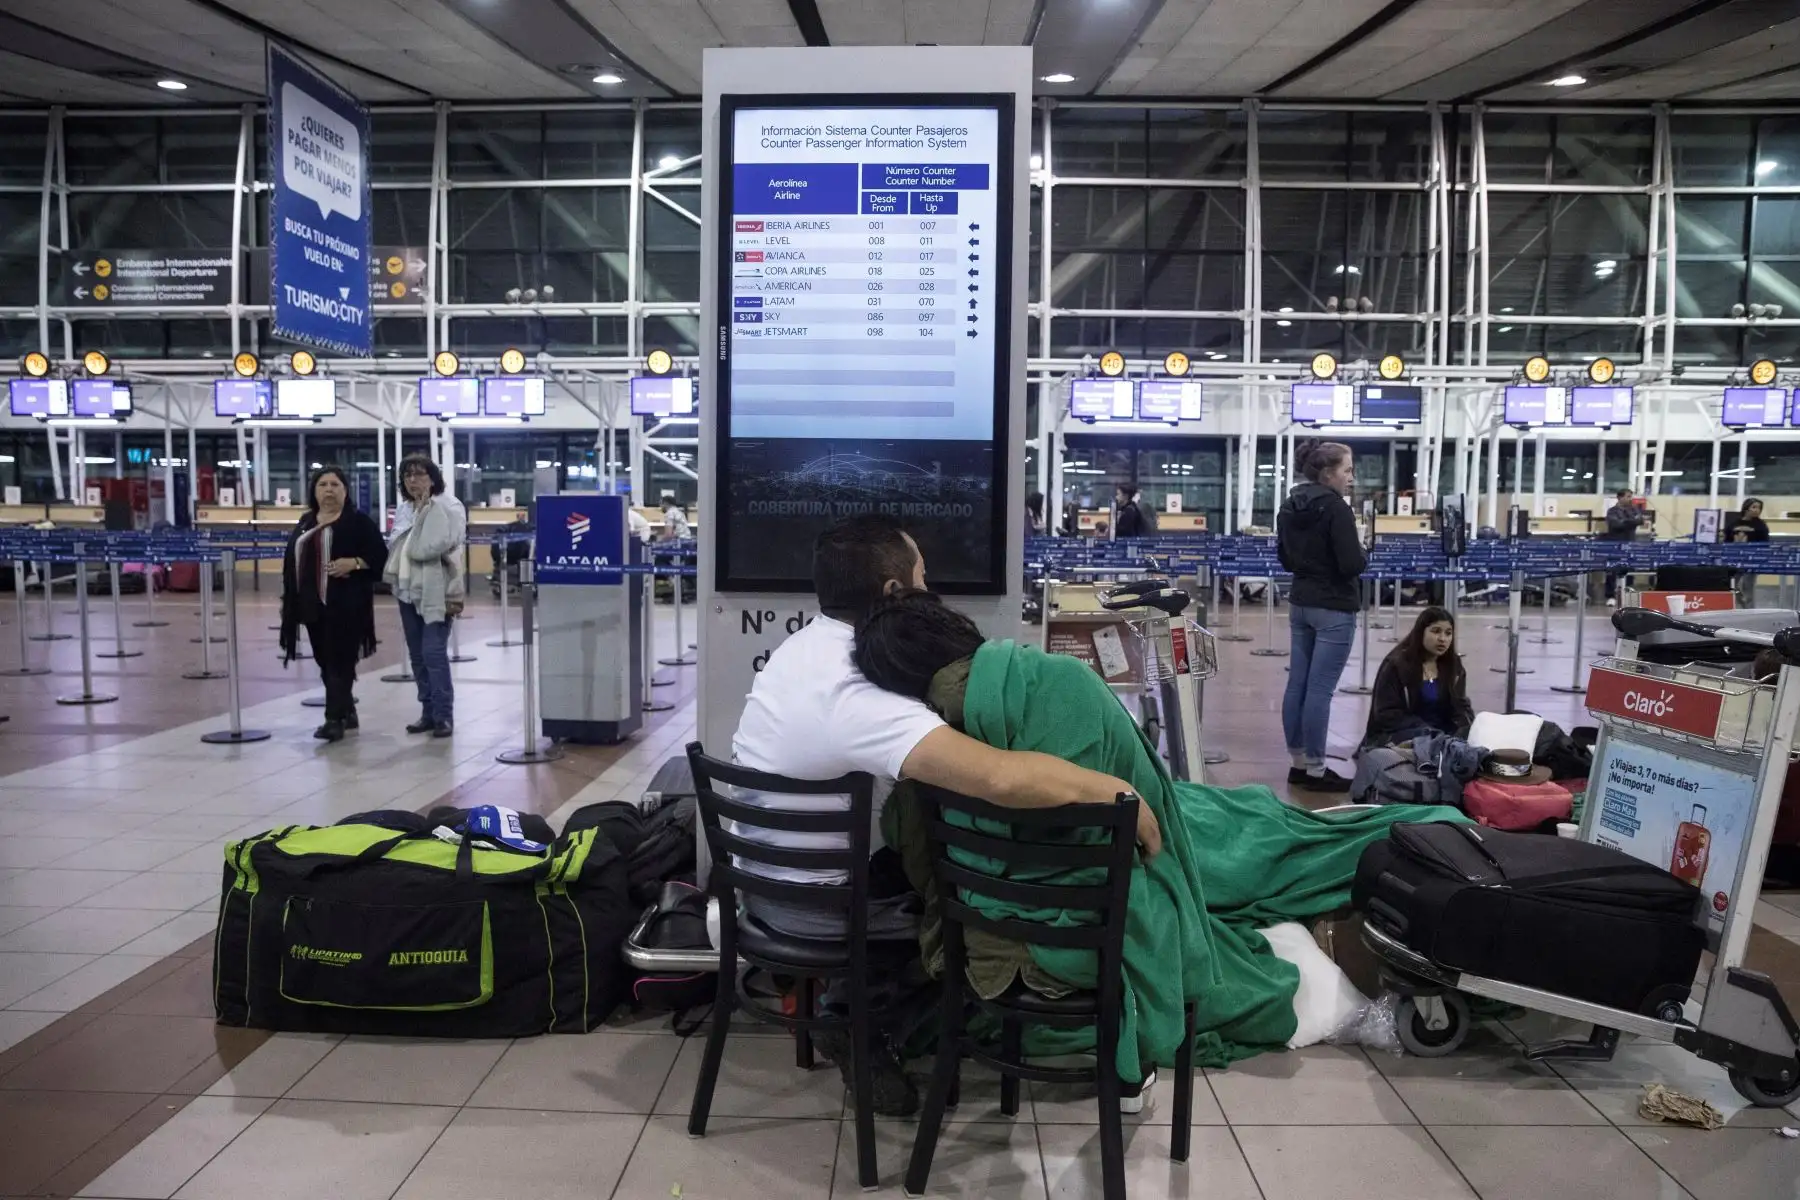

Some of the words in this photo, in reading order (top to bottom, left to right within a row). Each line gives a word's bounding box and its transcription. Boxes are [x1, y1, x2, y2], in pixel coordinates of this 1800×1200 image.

[301, 116, 344, 150] ¿QUIERES
[761, 125, 821, 136] Información
[826, 125, 866, 136] Sistema
[871, 125, 912, 136] Counter
[916, 125, 968, 138] Pasajeros
[760, 138, 801, 148] Counter
[805, 138, 861, 150] Passenger
[865, 138, 924, 148] Information
[927, 138, 967, 150] System
[288, 128, 321, 160] PAGAR
[324, 150, 356, 179] MENOS
[885, 166, 920, 175] Número
[922, 166, 956, 175] Counter
[294, 156, 314, 179] POR
[317, 168, 352, 198] VIAJAR?
[885, 177, 919, 186] Counter
[921, 177, 956, 186] Number
[768, 179, 808, 188] Aerolínea
[774, 191, 801, 200] Airline
[870, 194, 897, 203] Desde
[919, 194, 944, 203] Hasta
[872, 204, 894, 212] From
[925, 204, 938, 213] Up
[765, 221, 792, 230] IBERIA
[794, 221, 830, 230] AIRLINES
[868, 221, 884, 230] 001
[920, 221, 936, 230] 007
[284, 217, 312, 240] BUSCA
[313, 229, 324, 244] TU
[325, 234, 360, 260] PRÓXIMO
[765, 237, 791, 245] LEVEL
[868, 237, 885, 245] 008
[920, 237, 933, 245] 011
[304, 246, 330, 268] VUELO
[331, 257, 345, 273] EN:
[764, 251, 806, 260] AVIANCA
[868, 252, 883, 260] 012
[919, 252, 934, 260] 017
[116, 258, 165, 269] Embarques
[166, 258, 233, 267] Internacionales
[116, 268, 170, 277] International
[171, 268, 218, 278] Departures
[764, 267, 788, 275] COPA
[790, 267, 827, 275] AIRLINES
[868, 267, 883, 275] 018
[919, 267, 935, 276] 025
[764, 282, 812, 290] AMERICAN
[867, 282, 883, 290] 026
[919, 283, 935, 291] 028
[764, 297, 795, 305] LATAM
[867, 298, 881, 306] 031
[918, 298, 935, 306] 070
[739, 313, 757, 321] SKY
[764, 312, 781, 321] SKY
[867, 313, 884, 321] 086
[918, 313, 935, 321] 097
[763, 328, 808, 336] JETSMART
[867, 328, 884, 336] 098
[919, 328, 934, 336] 104
[749, 500, 832, 516] COBERTURA
[835, 501, 874, 516] TOTAL
[879, 502, 899, 517] DE
[902, 502, 973, 518] MERCADO
[1623, 691, 1667, 717] Claro
[1610, 758, 1637, 774] ¿Viajas
[1637, 765, 1644, 778] 3,
[1646, 768, 1652, 778] 7
[1652, 771, 1657, 780] o
[1657, 772, 1675, 786] más
[1676, 777, 1699, 793] días?
[1608, 771, 1621, 784] ¡No
[1622, 775, 1656, 795] importa!
[1604, 798, 1621, 812] Claro
[1621, 804, 1635, 818] Max
[388, 950, 469, 966] ANTIOQUIA
